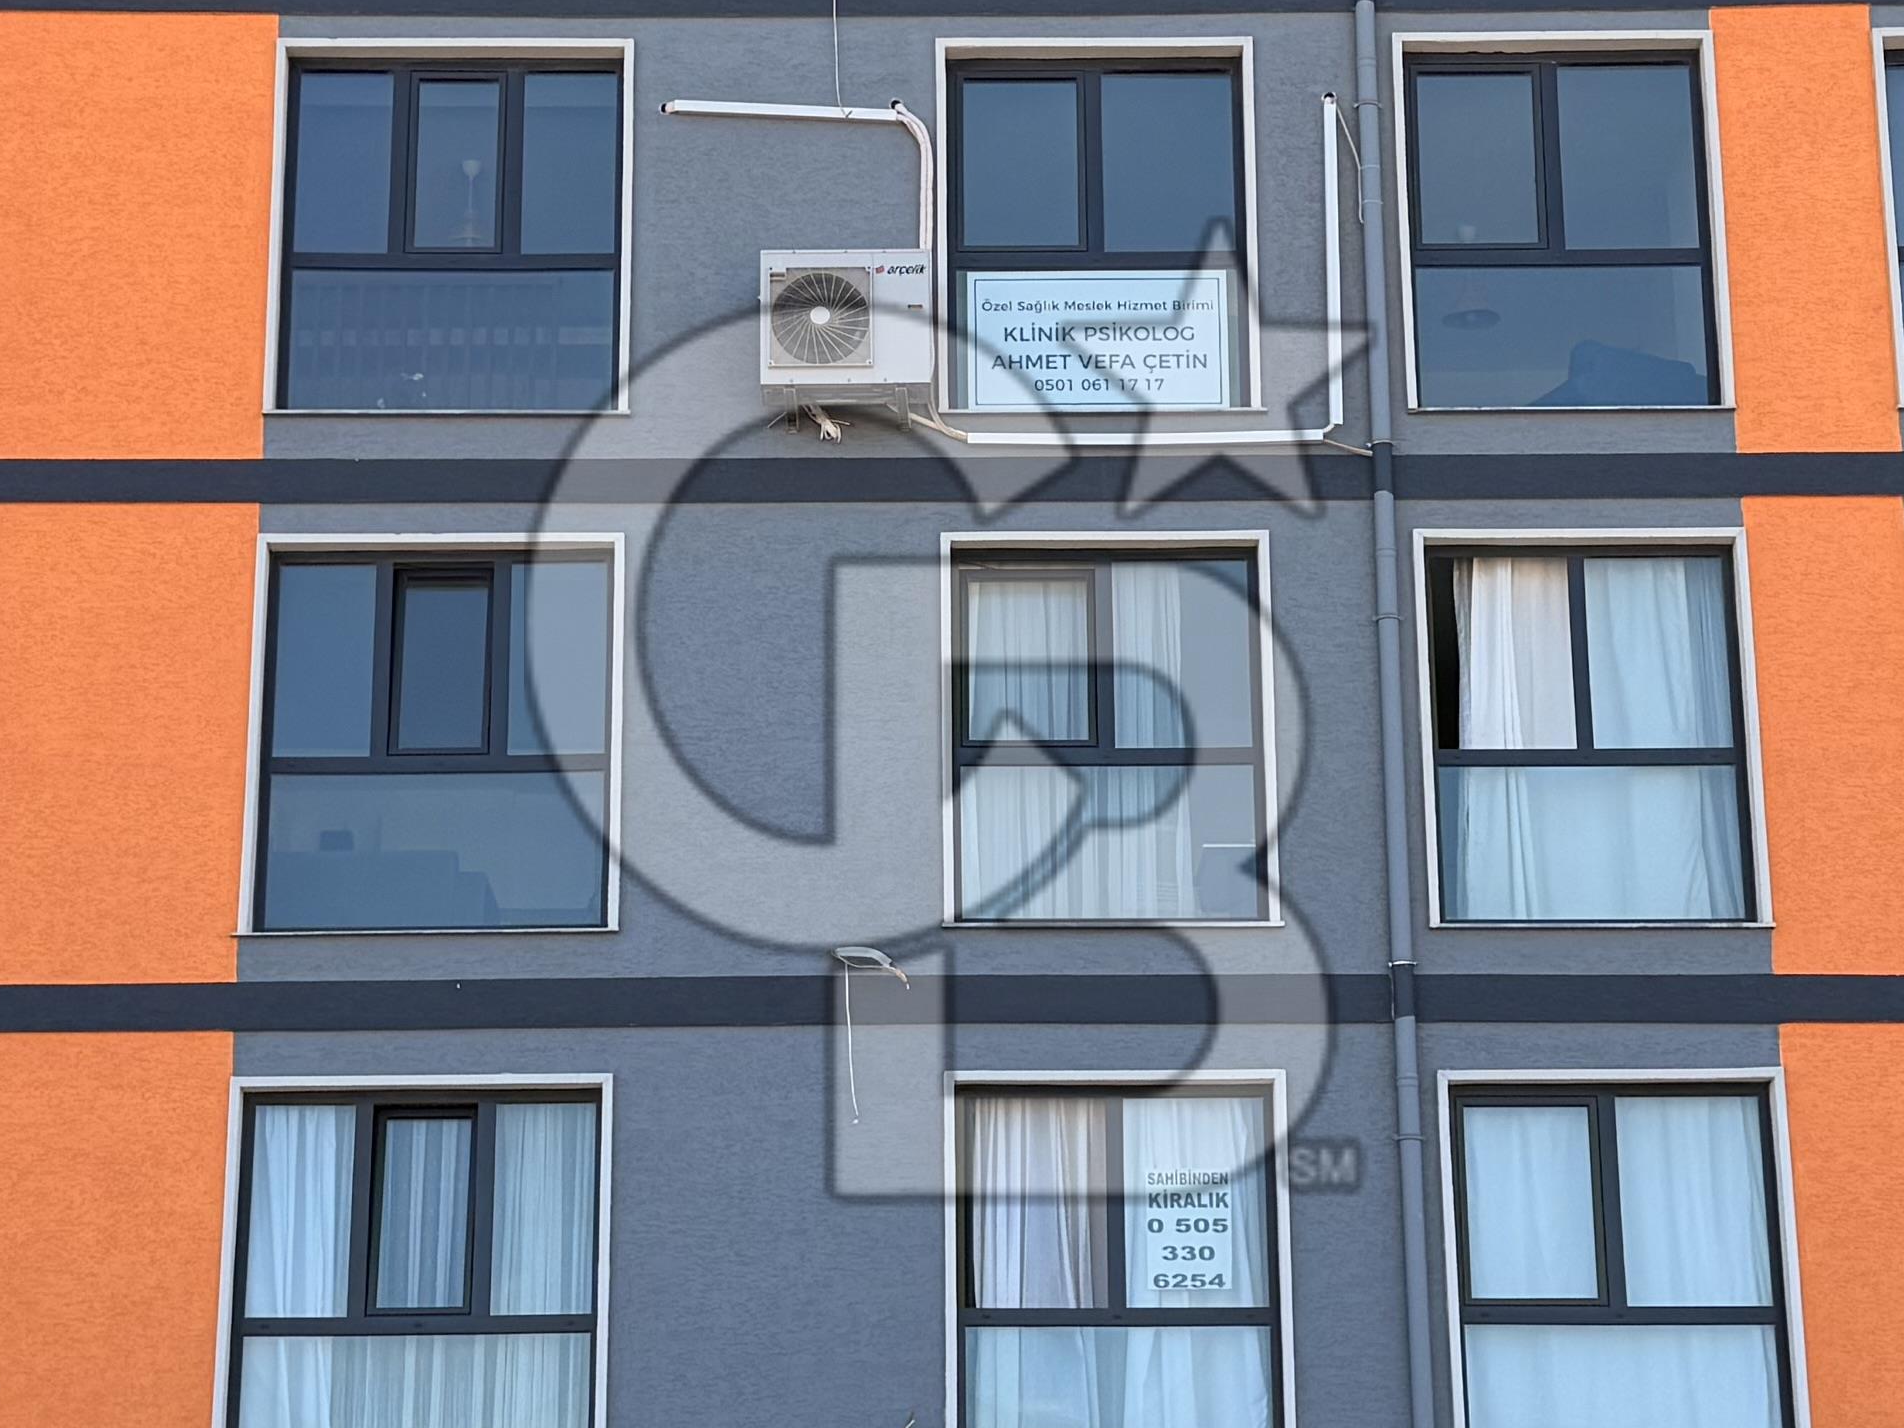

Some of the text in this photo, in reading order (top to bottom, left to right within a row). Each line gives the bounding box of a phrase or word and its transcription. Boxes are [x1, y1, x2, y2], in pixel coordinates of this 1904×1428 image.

[887, 264, 926, 277] arçelik
[981, 298, 1214, 313] Özel Sağlık Meslek Hizmet Birimi
[1004, 322, 1195, 343] KLİNİK PSİKOLOG
[992, 349, 1208, 373] AHMET VEFA ÇETİN
[1034, 378, 1164, 392] 0501 061 17 17
[1147, 1169, 1229, 1185] SAHİBİNDEN
[1148, 1189, 1229, 1209] KİRALIK
[1147, 1218, 1228, 1233] 0 505
[1161, 1245, 1216, 1261] 330
[1153, 1273, 1226, 1289] 6254
